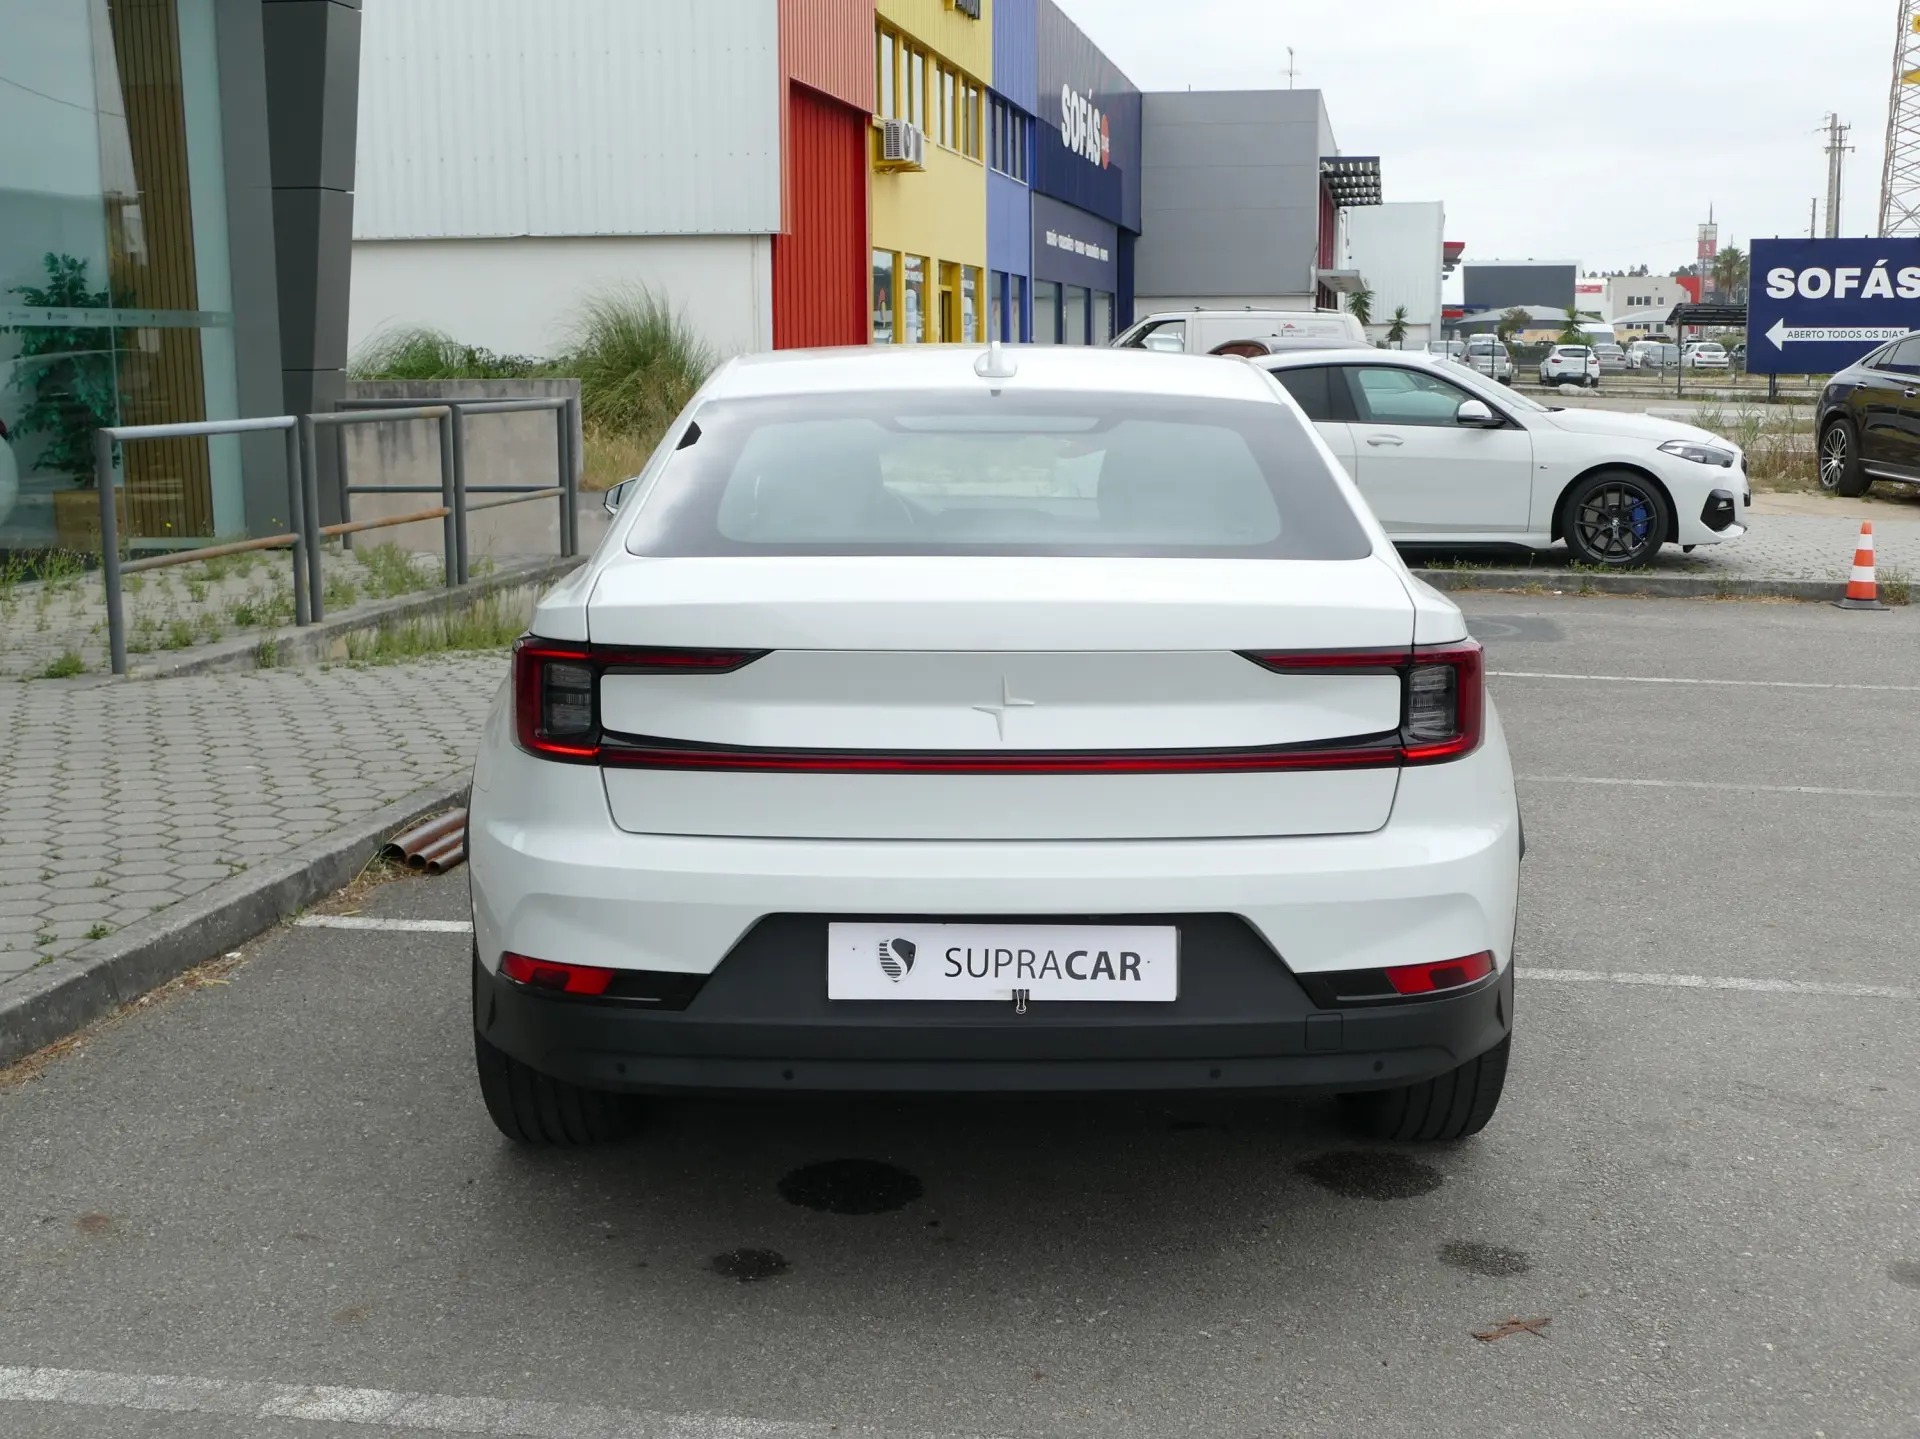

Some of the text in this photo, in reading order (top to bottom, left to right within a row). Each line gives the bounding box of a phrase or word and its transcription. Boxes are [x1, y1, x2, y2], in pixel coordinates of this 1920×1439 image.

[1061, 84, 1101, 167] SOFÁS
[1766, 259, 1920, 299] SOFÁS
[1787, 330, 1824, 339] ABERTO
[1827, 330, 1861, 339] TODOS
[1865, 330, 1879, 339] OS
[944, 947, 1142, 981] SUPRACAR
